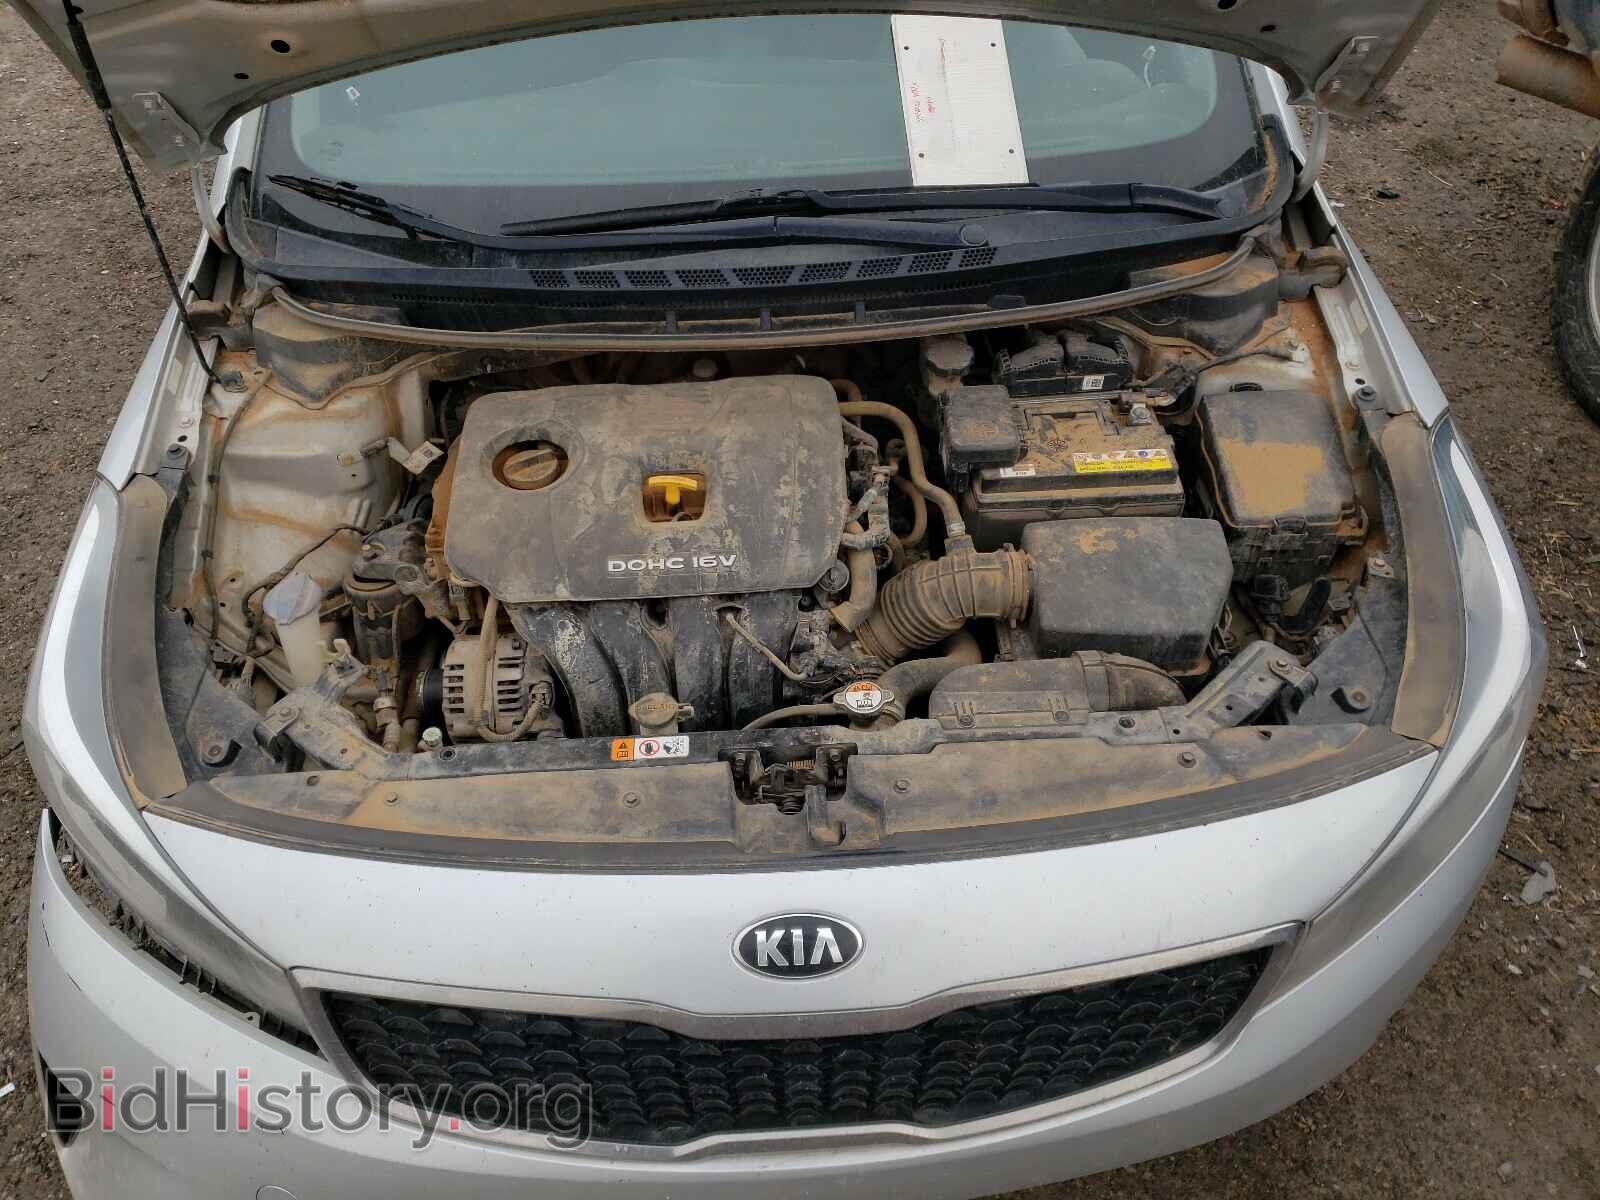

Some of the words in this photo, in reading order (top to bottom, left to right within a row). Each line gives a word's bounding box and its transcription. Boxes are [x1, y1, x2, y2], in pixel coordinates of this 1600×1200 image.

[607, 557, 685, 572] DOHC
[692, 554, 737, 568] 16V
[754, 927, 844, 967] KIA
